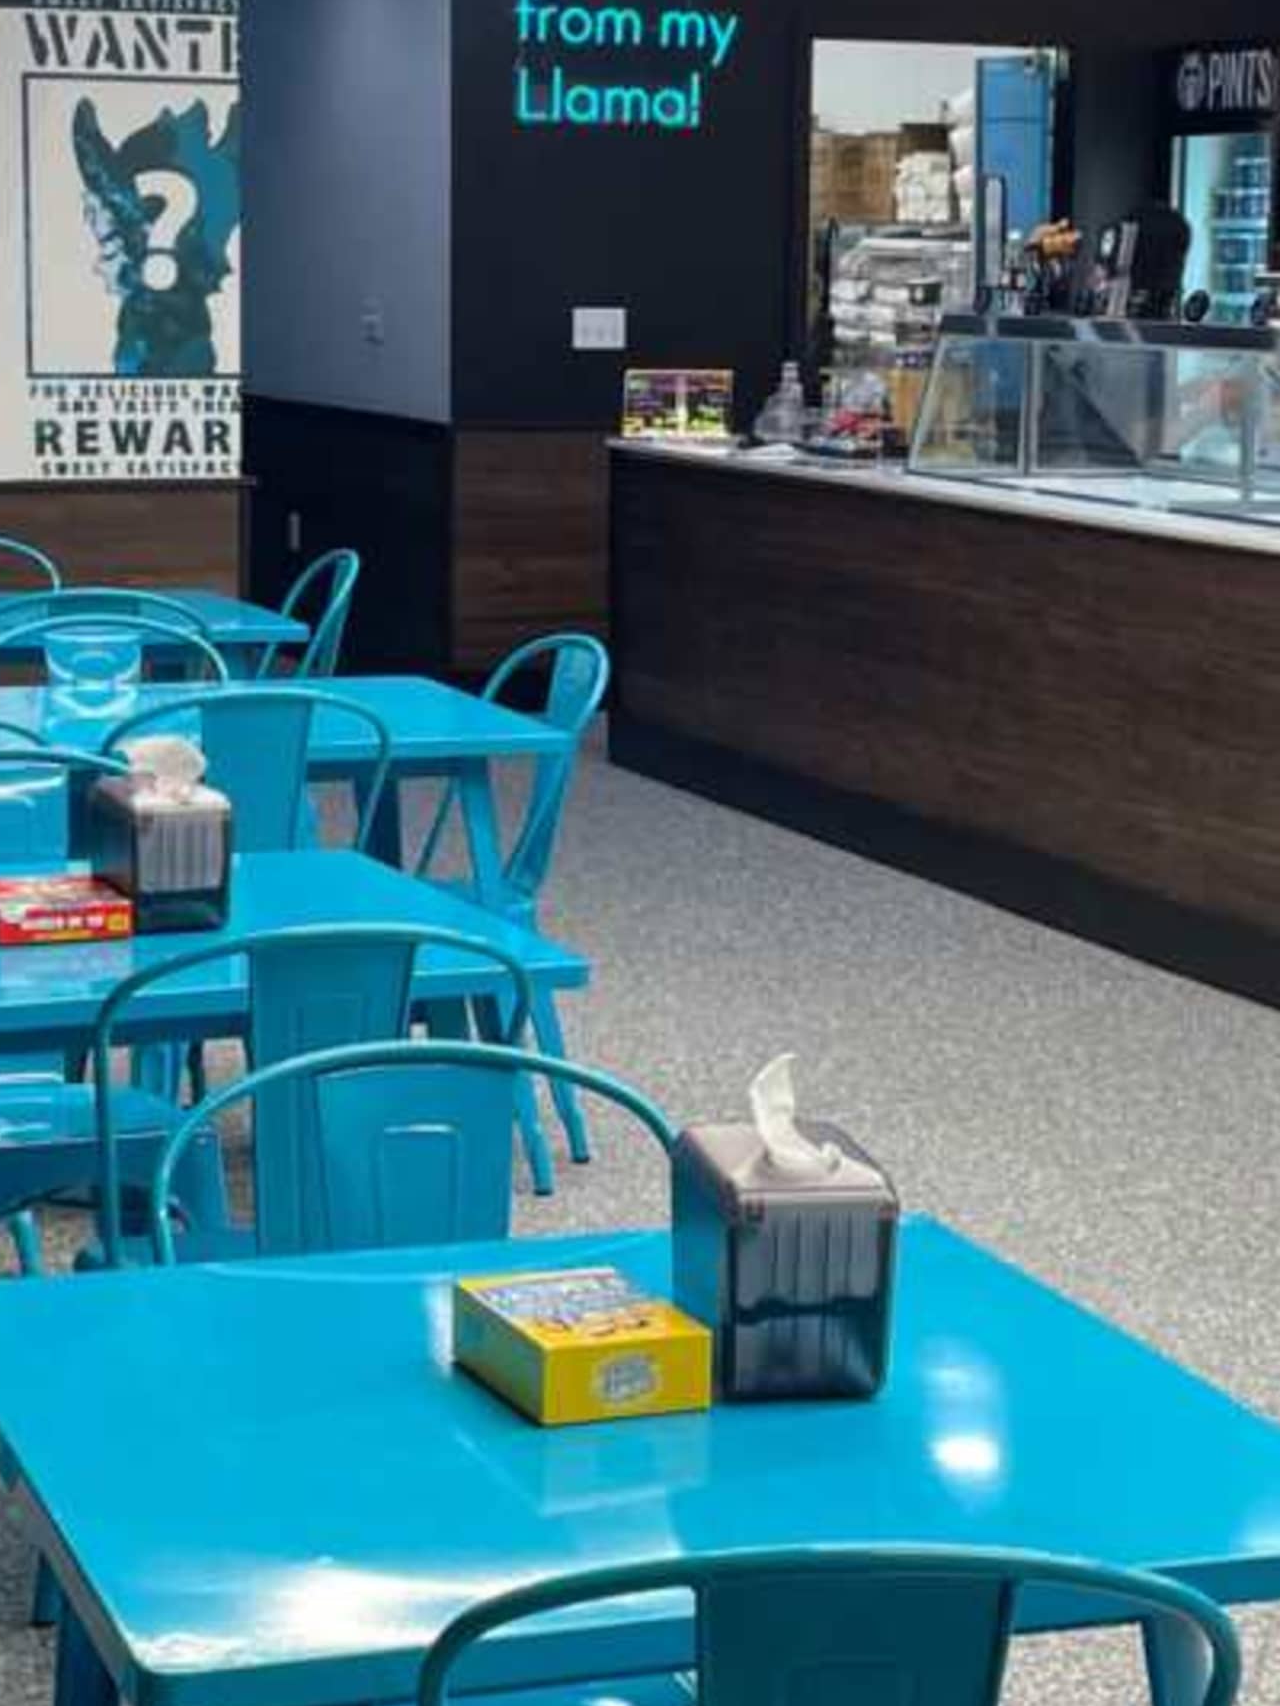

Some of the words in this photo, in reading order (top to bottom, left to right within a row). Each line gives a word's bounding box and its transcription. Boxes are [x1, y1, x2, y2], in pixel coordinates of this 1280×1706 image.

[660, 10, 737, 67] my
[518, 66, 701, 128] Llama!
[1208, 49, 1273, 110] PINTS
[34, 420, 231, 456] REWAR
